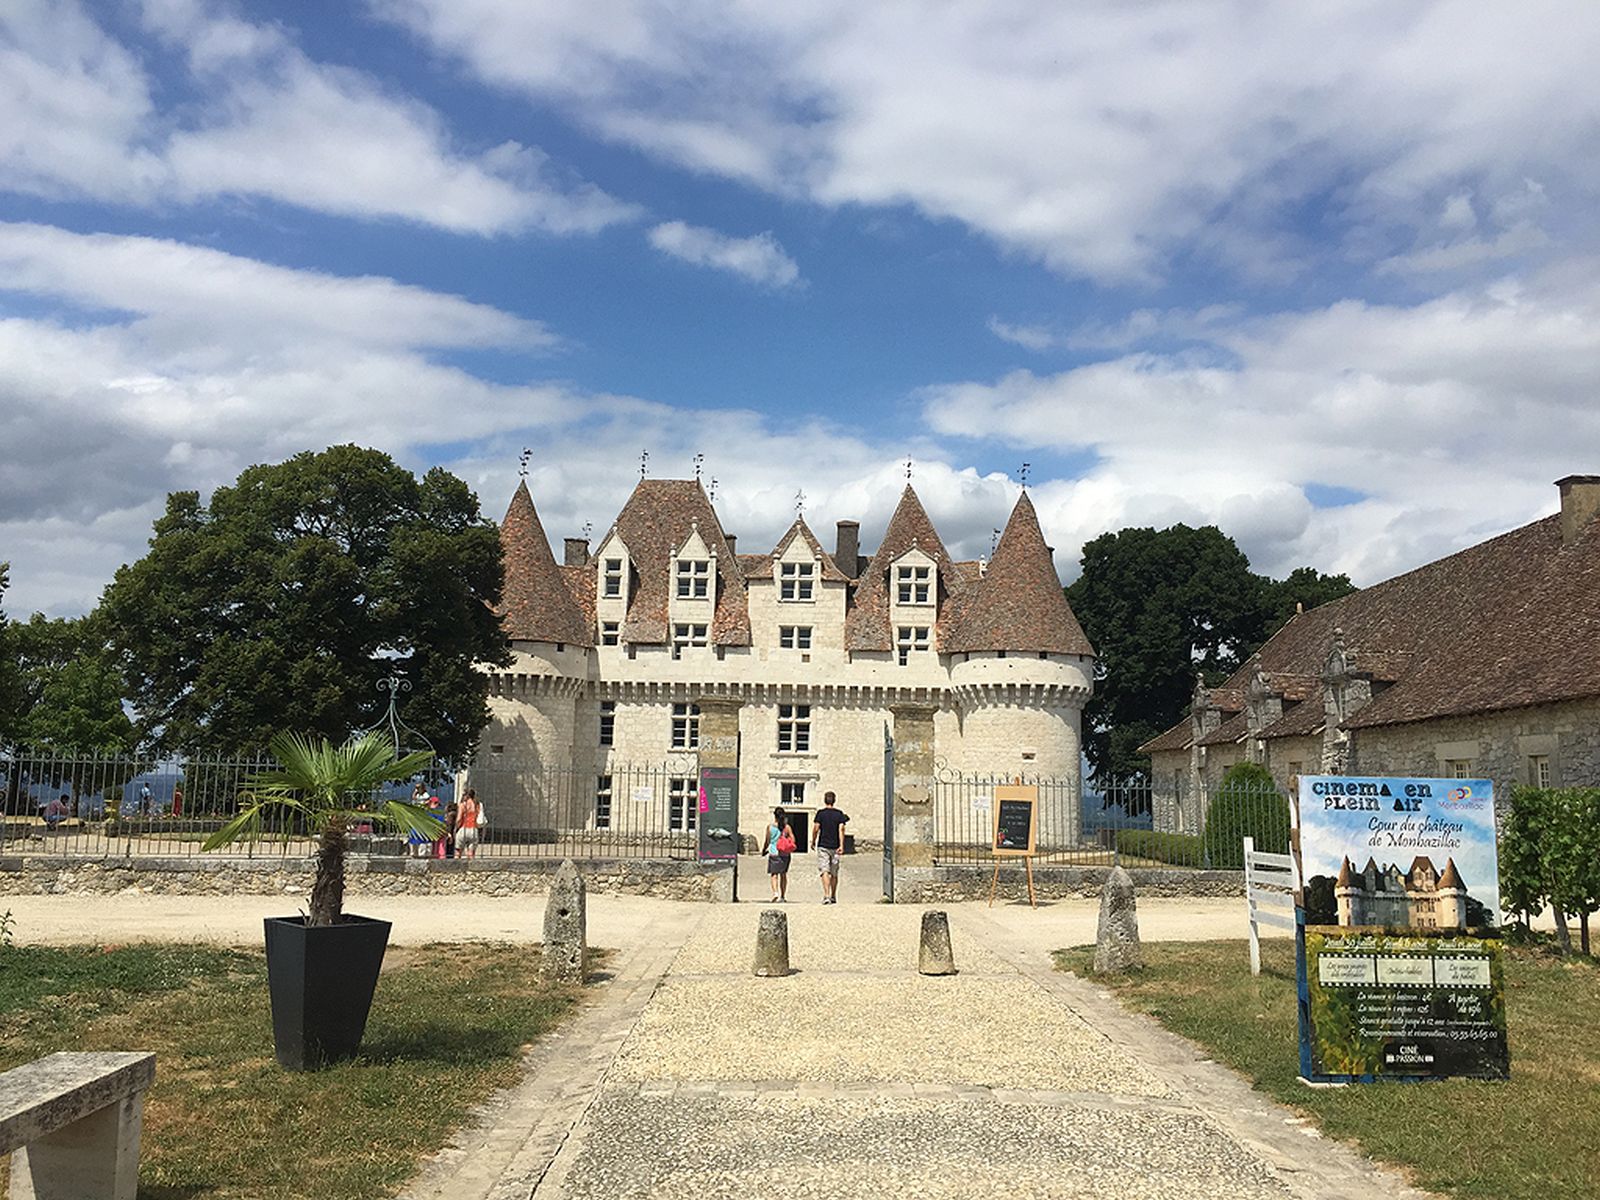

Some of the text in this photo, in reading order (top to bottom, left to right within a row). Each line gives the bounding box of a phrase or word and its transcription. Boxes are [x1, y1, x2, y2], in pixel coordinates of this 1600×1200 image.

[1404, 784, 1432, 797] en
[1393, 798, 1423, 811] Air
[1368, 814, 1463, 832] Cour du château
[1368, 829, 1460, 848] de Monbazillac
